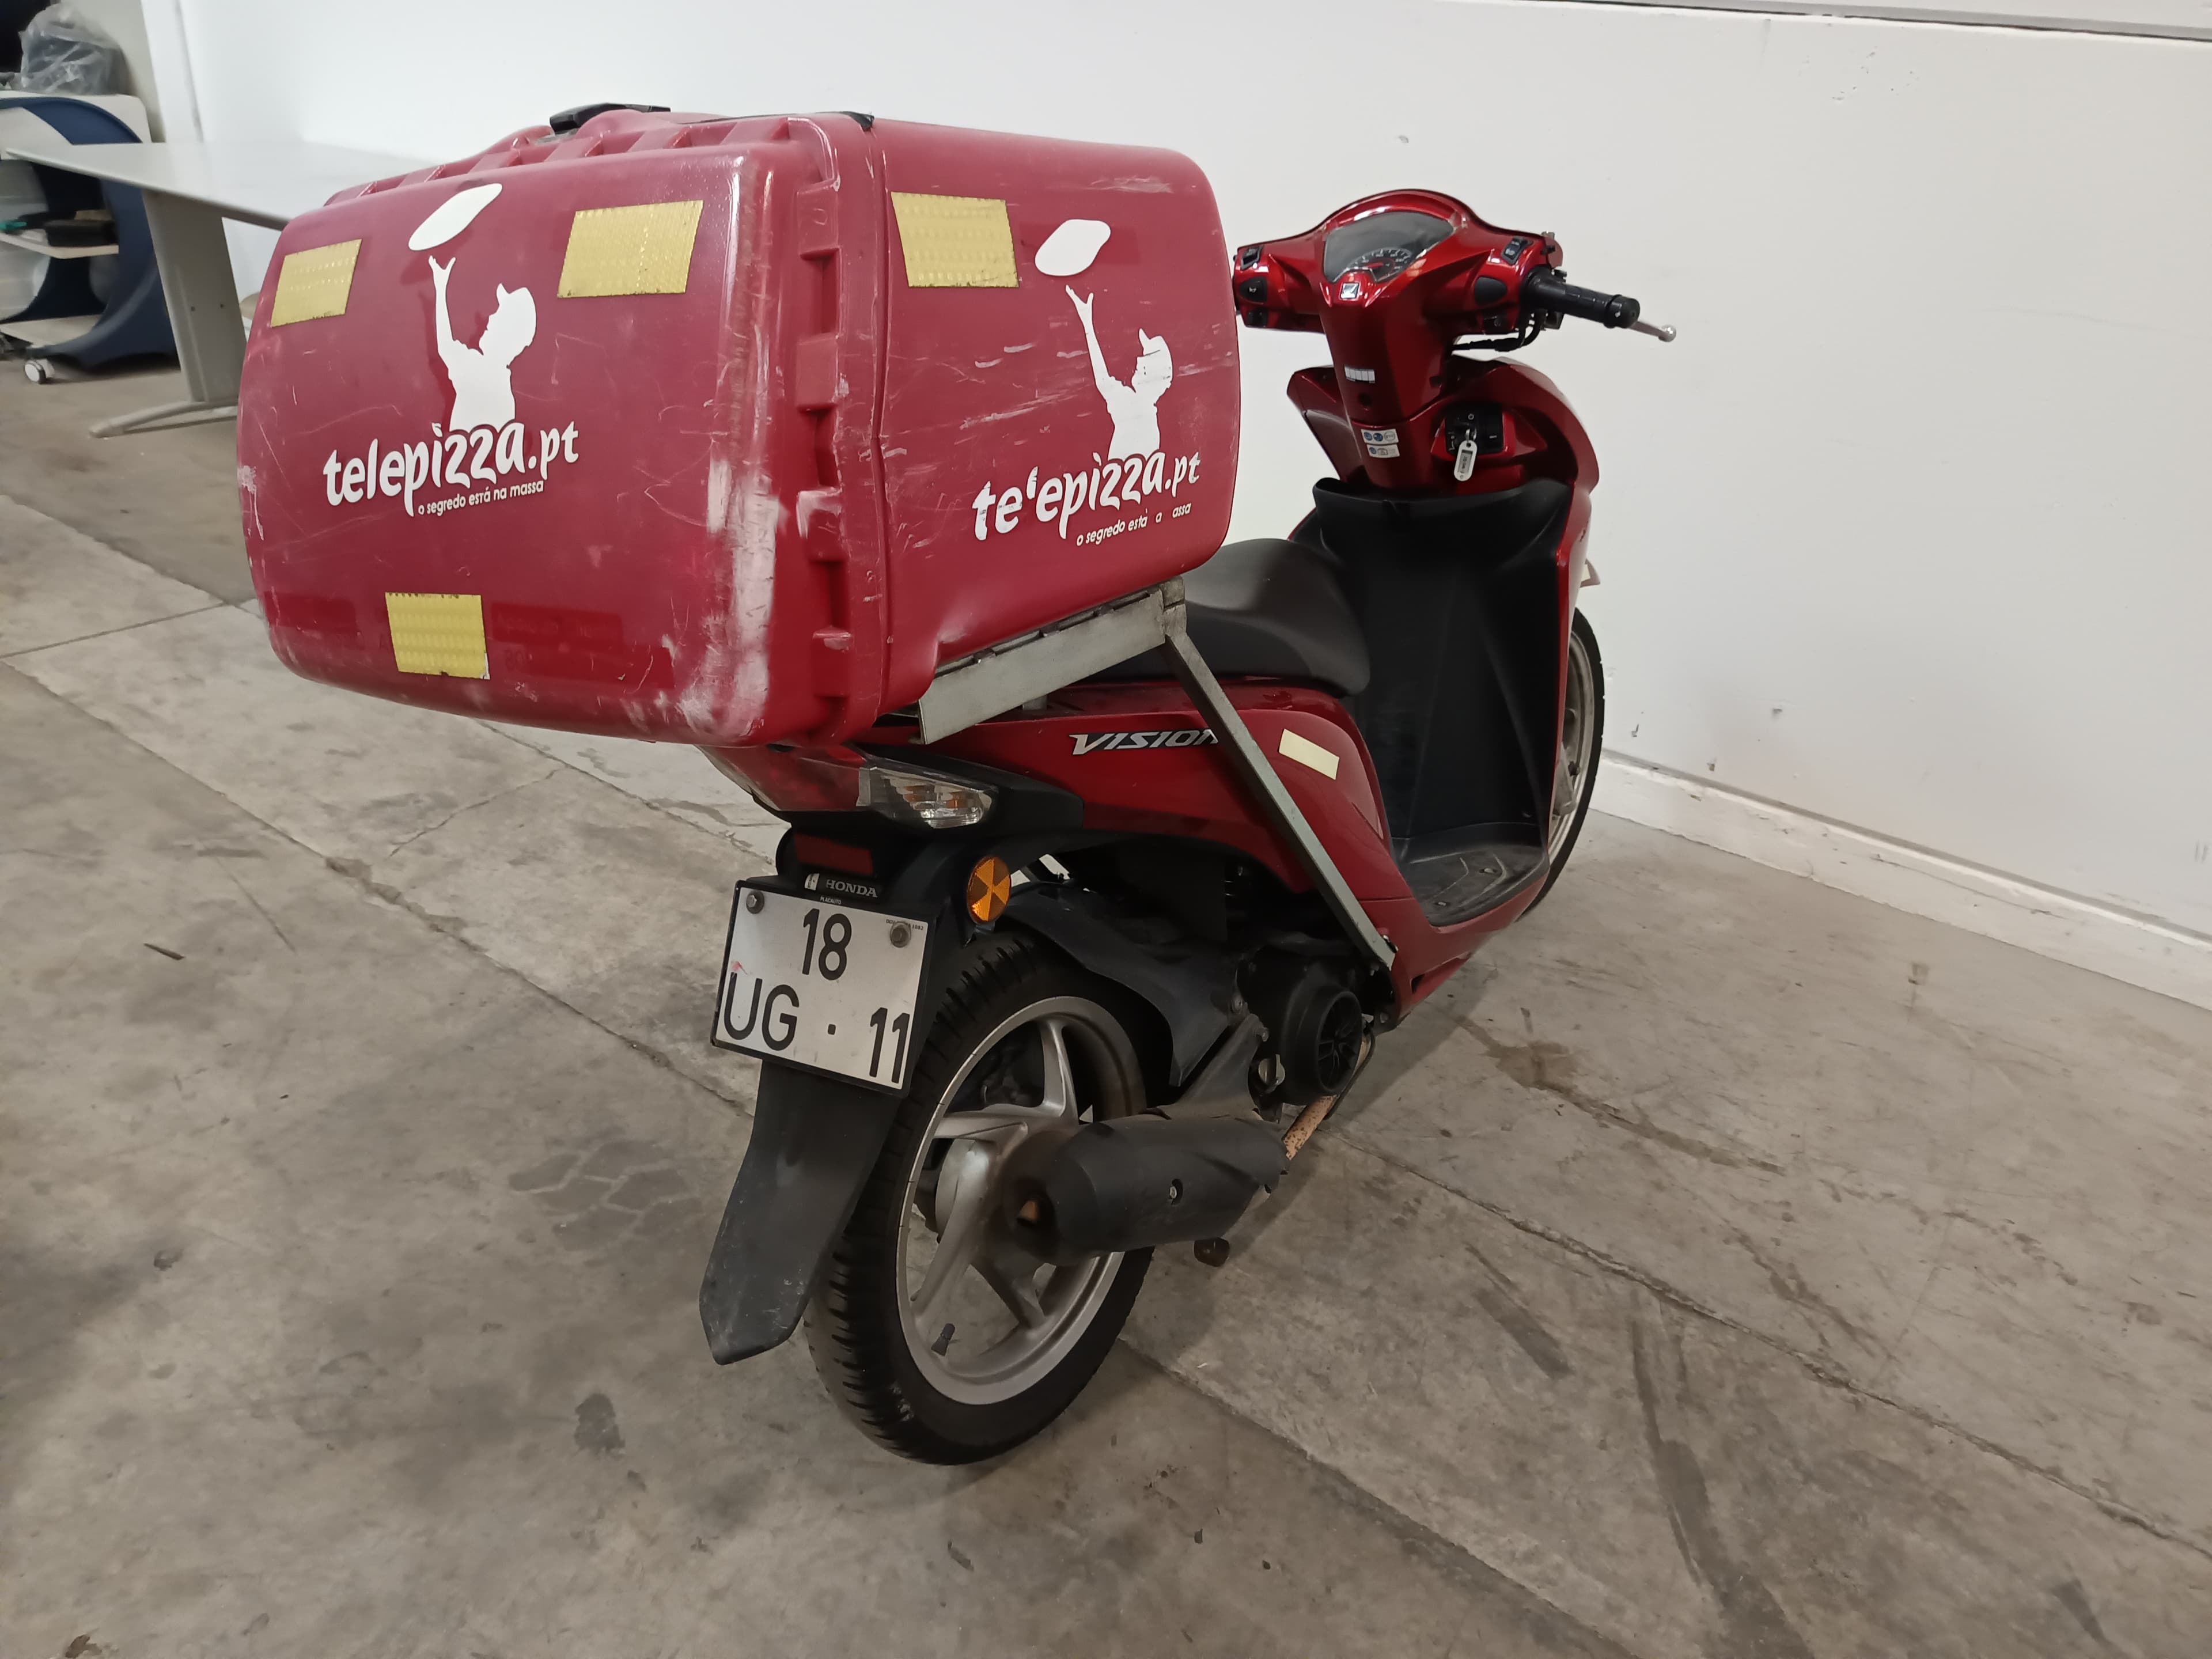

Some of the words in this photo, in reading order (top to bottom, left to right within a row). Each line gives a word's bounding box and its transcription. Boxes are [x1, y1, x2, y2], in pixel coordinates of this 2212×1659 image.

[418, 505, 425, 515] o
[427, 493, 466, 517] segredo
[468, 486, 491, 506] está
[493, 487, 507, 501] na
[510, 480, 544, 498] massa
[1077, 535, 1084, 547] o
[1085, 519, 1126, 545] segredo
[826, 879, 878, 898] HONDA
[802, 908, 852, 980] 18
[724, 972, 800, 1051] UG
[869, 1007, 911, 1084] 11
